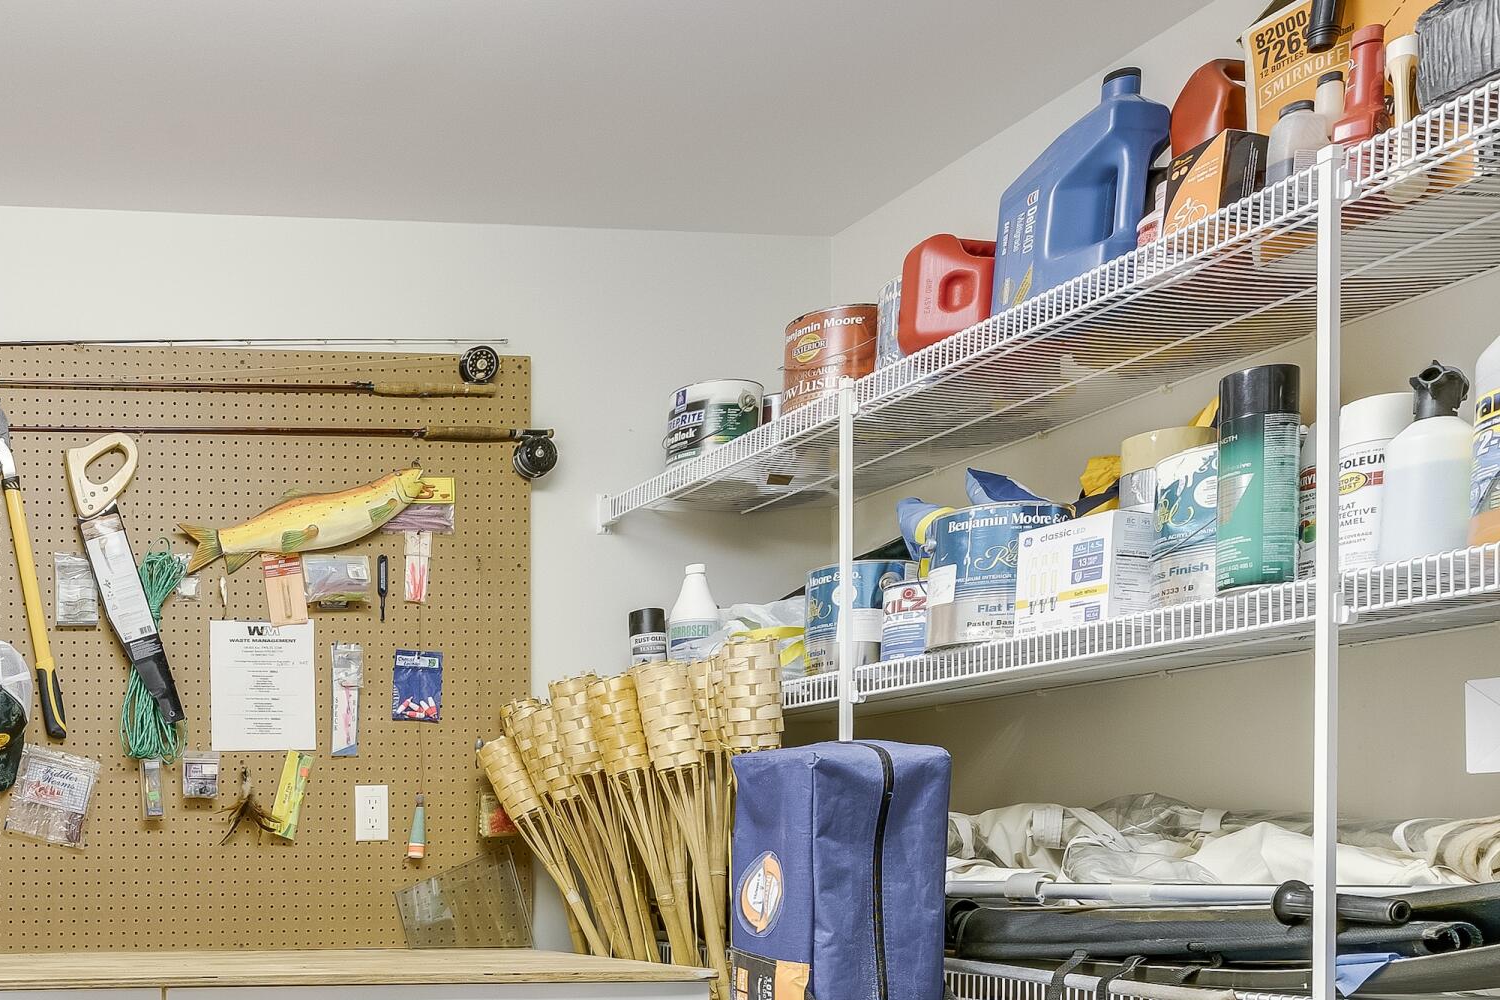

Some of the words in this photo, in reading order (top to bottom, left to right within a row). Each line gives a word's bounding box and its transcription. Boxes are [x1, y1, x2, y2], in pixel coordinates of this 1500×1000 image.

[1260, 69, 1269, 79] 12
[1271, 50, 1304, 74] BOTTLES
[1264, 46, 1345, 101] SMIRNOFF
[1025, 205, 1038, 234] Delo
[1022, 234, 1034, 254] 400
[824, 316, 865, 329] Moore
[794, 342, 826, 356] EXTERIOR
[948, 515, 1007, 533] Benjamin
[1011, 512, 1051, 525] Moore
[1040, 529, 1072, 543] classic
[1073, 528, 1085, 536] LED
[1078, 558, 1087, 566] 13
[1169, 561, 1209, 577] Finish
[884, 596, 927, 615] KILZ
[978, 602, 1003, 613] Flat
[885, 611, 928, 622] ATEX
[967, 620, 993, 628] Pastel
[248, 625, 280, 636] WM
[635, 635, 666, 645] RUST-OLEU
[41, 766, 78, 783] Fiddler
[42, 775, 76, 790] Worms
